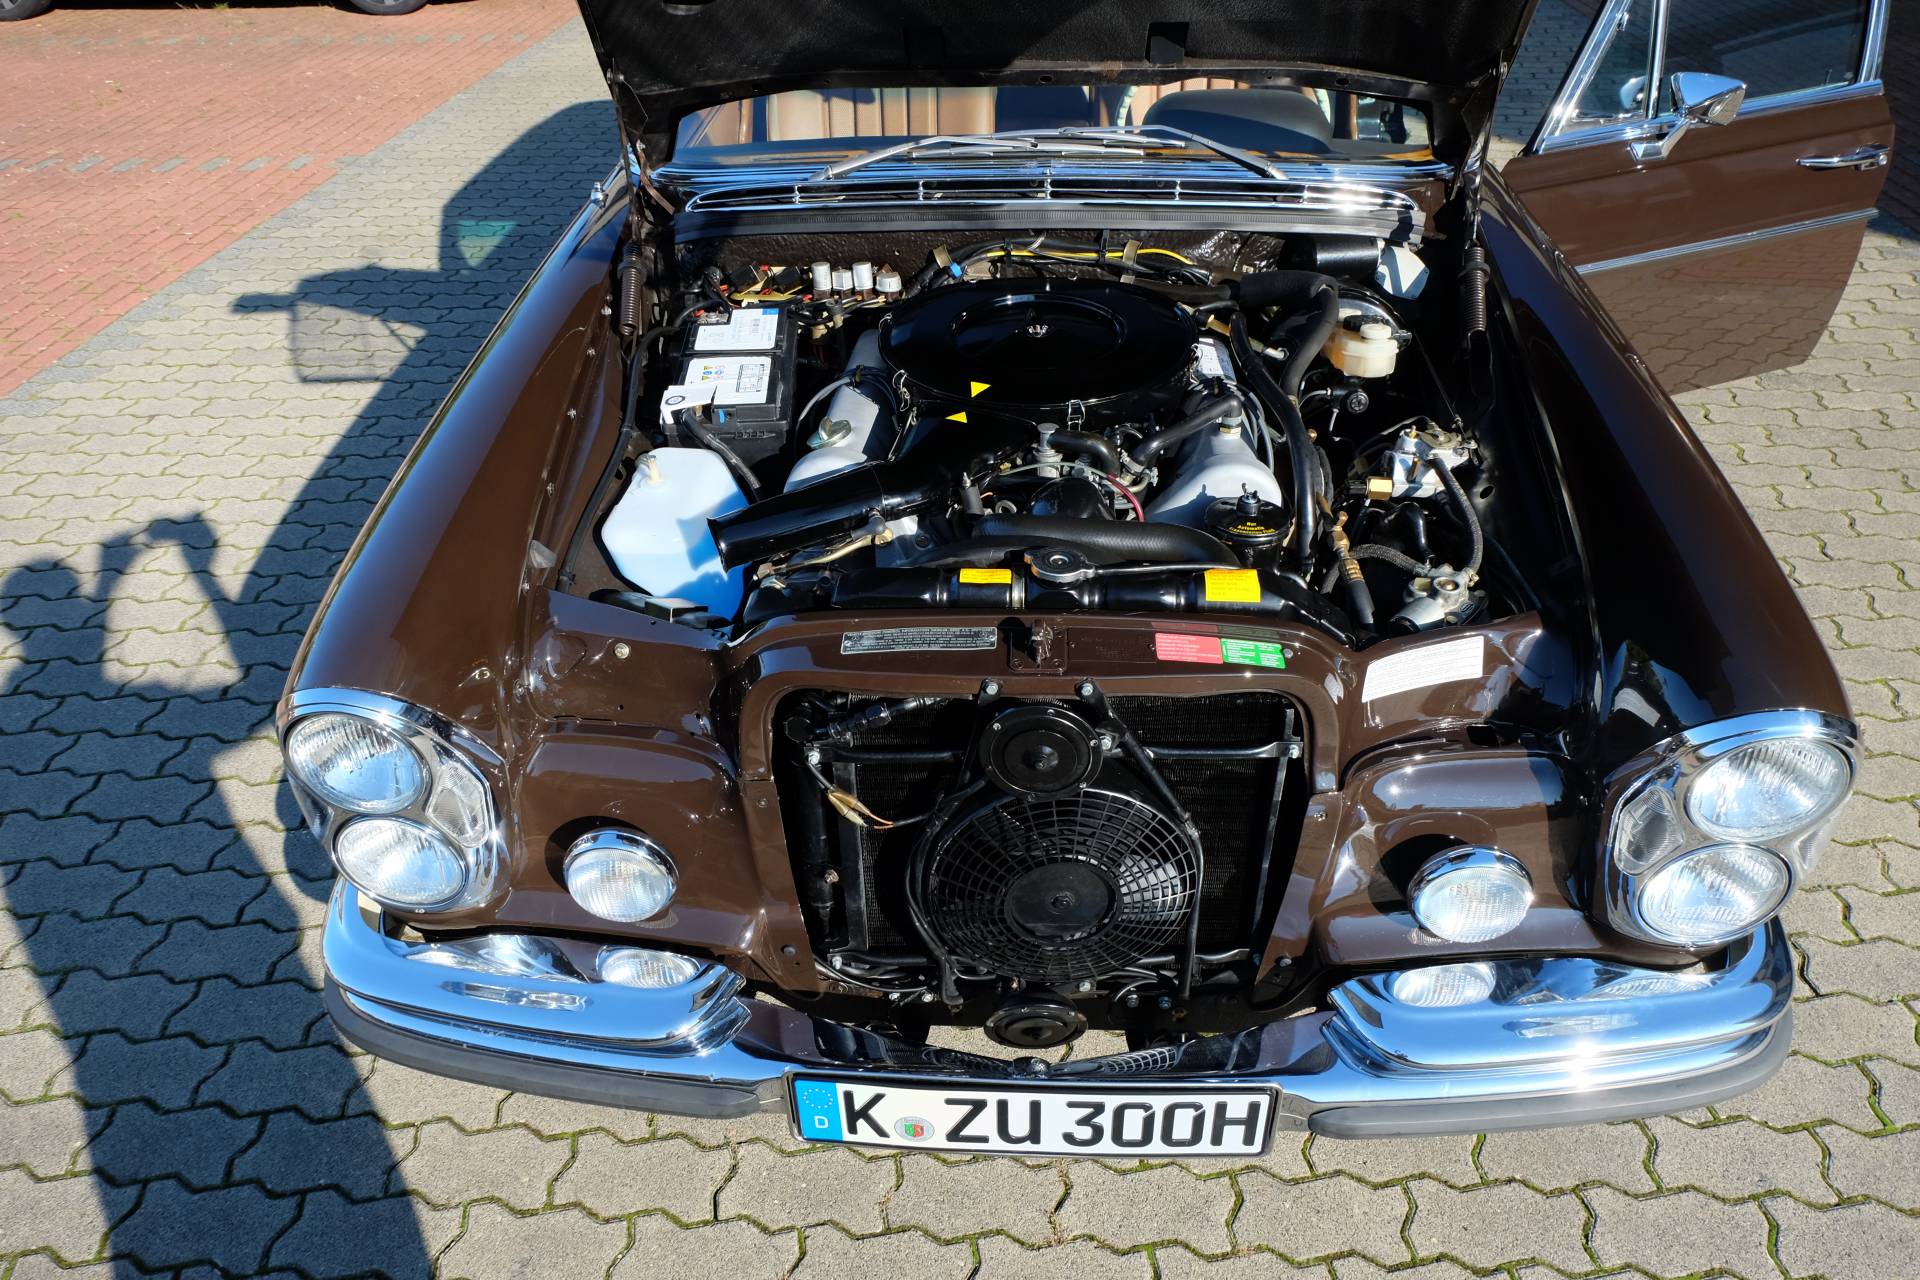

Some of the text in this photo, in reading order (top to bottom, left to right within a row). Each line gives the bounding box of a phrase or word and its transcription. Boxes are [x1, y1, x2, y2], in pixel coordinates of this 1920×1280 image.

[814, 1115, 829, 1129] D
[843, 1090, 890, 1138] K
[944, 1098, 1042, 1145] ZU
[1062, 1100, 1261, 1148] 300H
